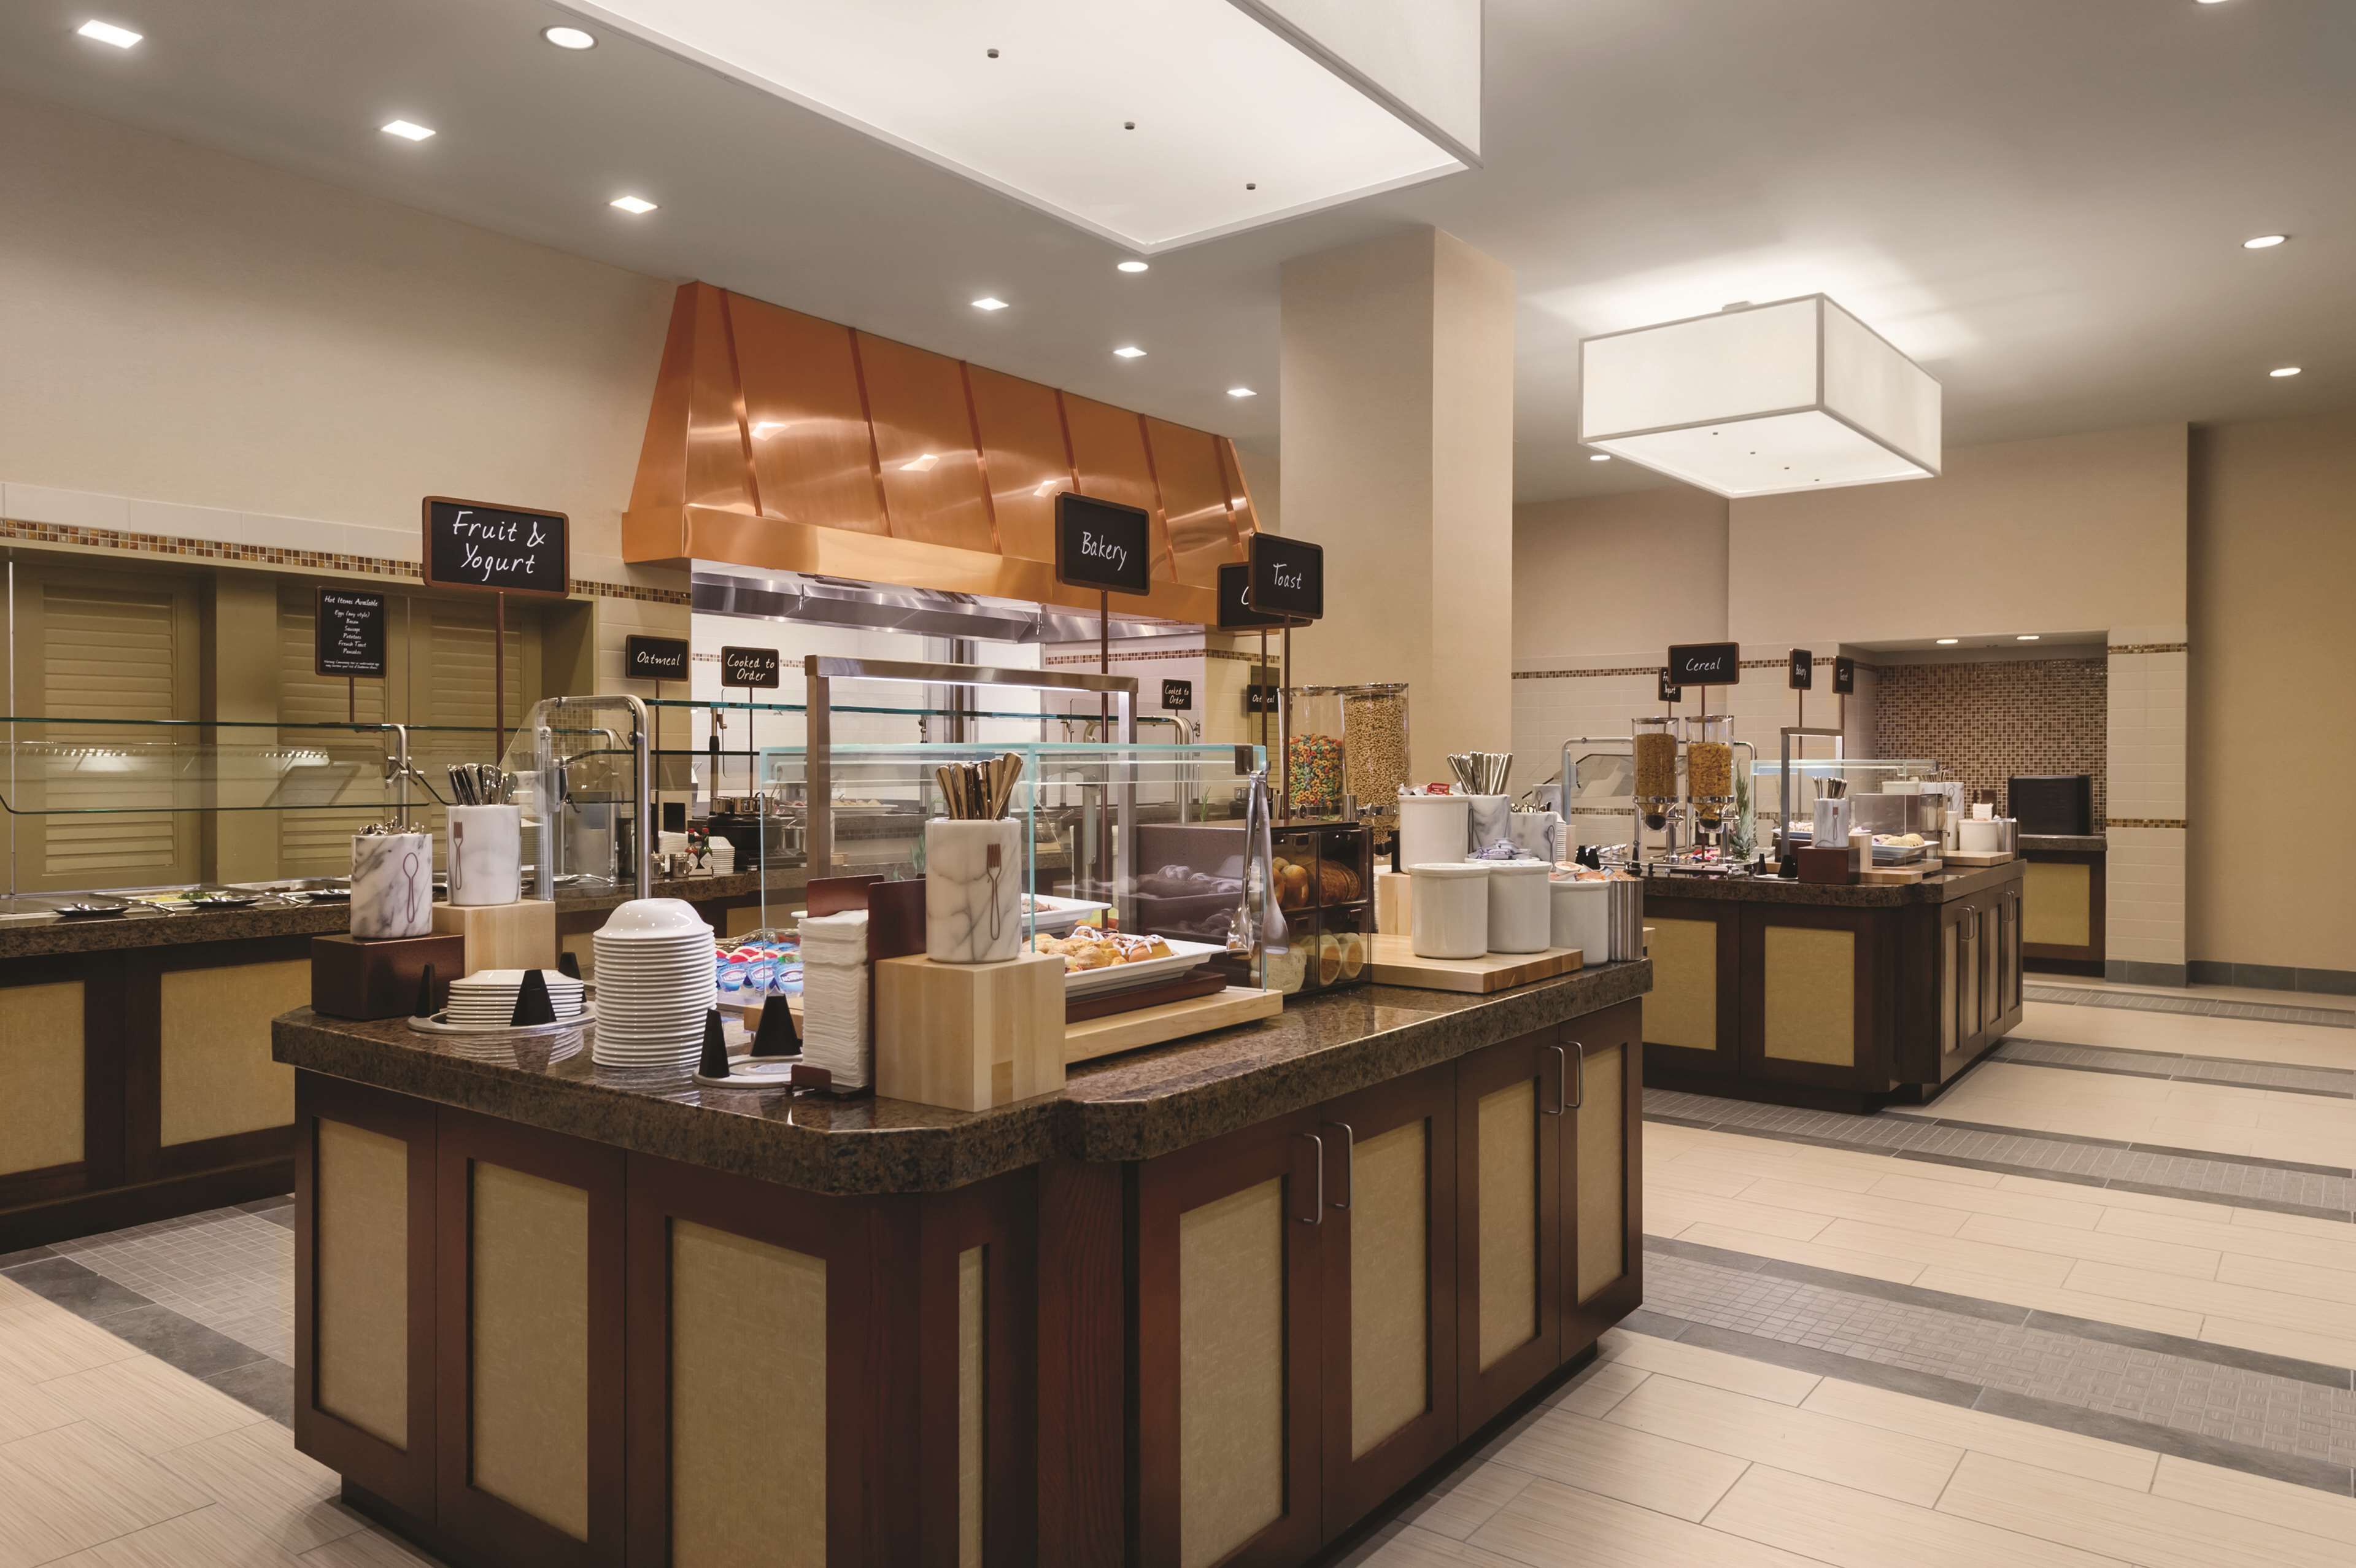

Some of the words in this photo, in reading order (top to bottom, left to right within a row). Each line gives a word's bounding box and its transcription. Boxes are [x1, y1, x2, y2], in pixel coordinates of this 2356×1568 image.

[452, 511, 517, 543] Fruit
[528, 521, 546, 547] &
[1081, 531, 1127, 571] Bakery
[460, 543, 536, 582] Yogurt
[1273, 562, 1302, 590] Toast
[355, 598, 379, 607] Available
[637, 651, 681, 666] Oatmeal
[727, 653, 762, 668] Cooked
[765, 658, 775, 669] to
[1686, 657, 1721, 671] Cereal
[737, 668, 766, 682] Order
[1165, 685, 1182, 695] Cooked
[1169, 695, 1184, 705] Order
[1252, 694, 1275, 703] Oateal
